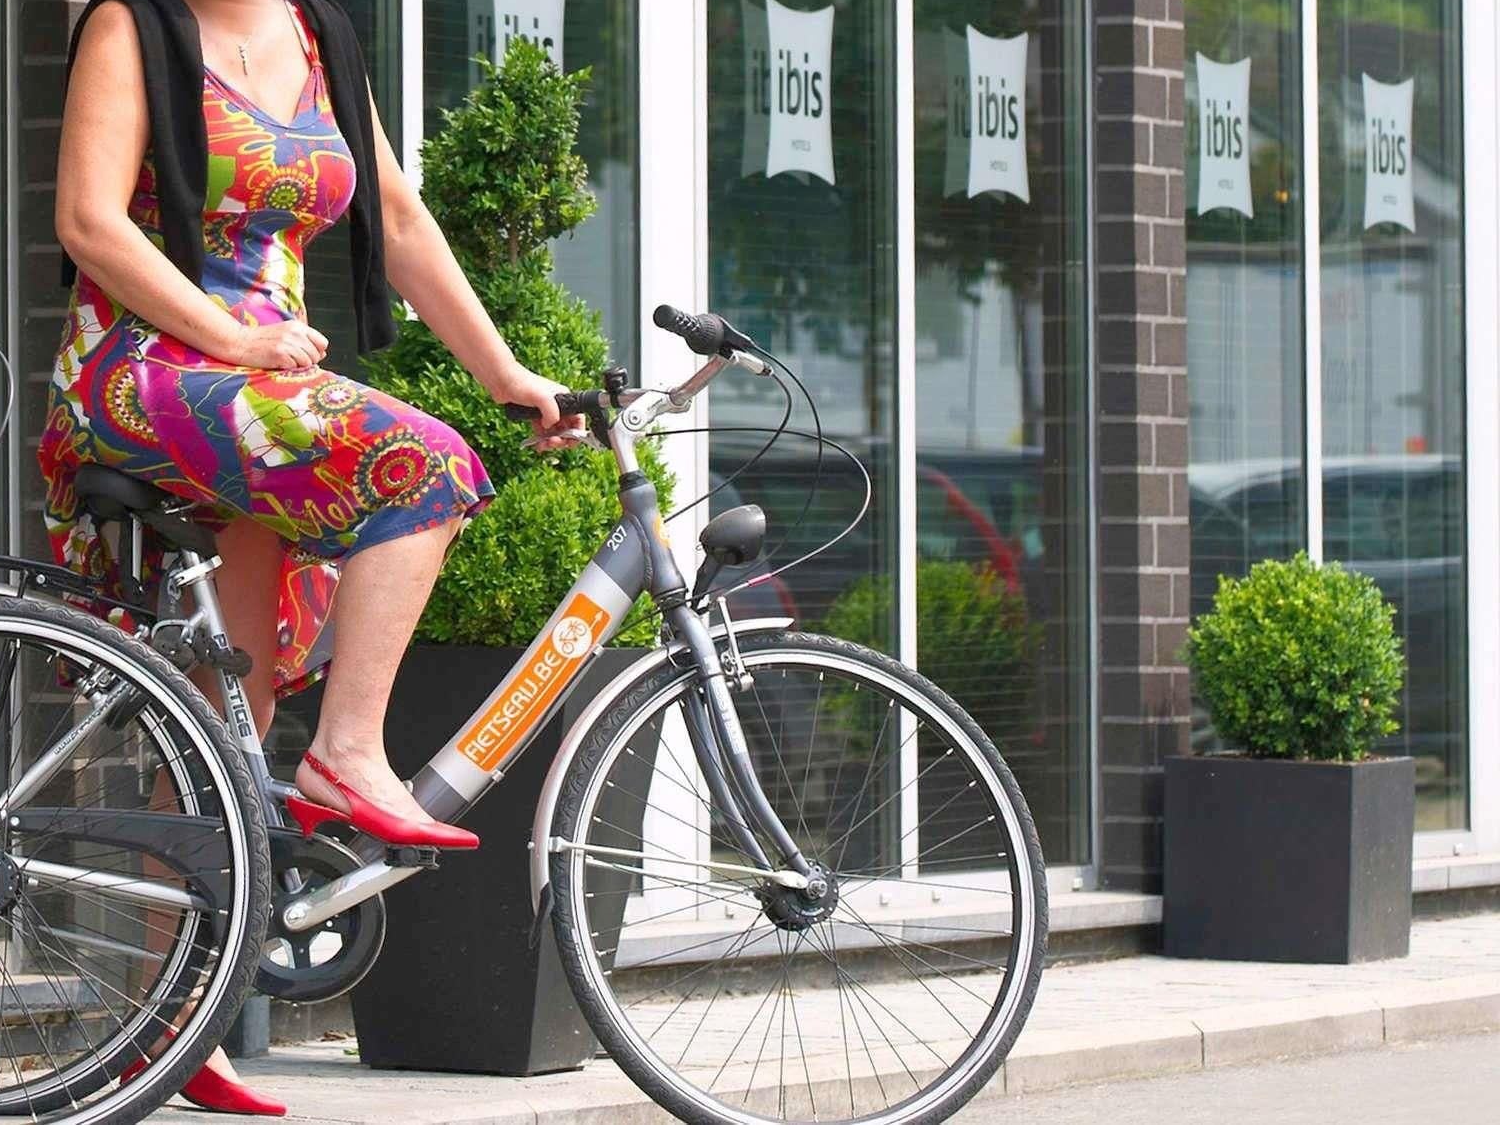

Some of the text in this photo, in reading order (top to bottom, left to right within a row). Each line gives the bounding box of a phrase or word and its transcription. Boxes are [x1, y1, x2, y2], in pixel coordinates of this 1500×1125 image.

[778, 48, 824, 119] ibis
[978, 74, 1019, 141] ibis
[1206, 98, 1243, 160] ibis
[1371, 117, 1407, 177] ibis
[606, 525, 627, 552] 207
[212, 632, 253, 739] PSTIGE
[463, 649, 563, 762] FIETSERIJ.BE
